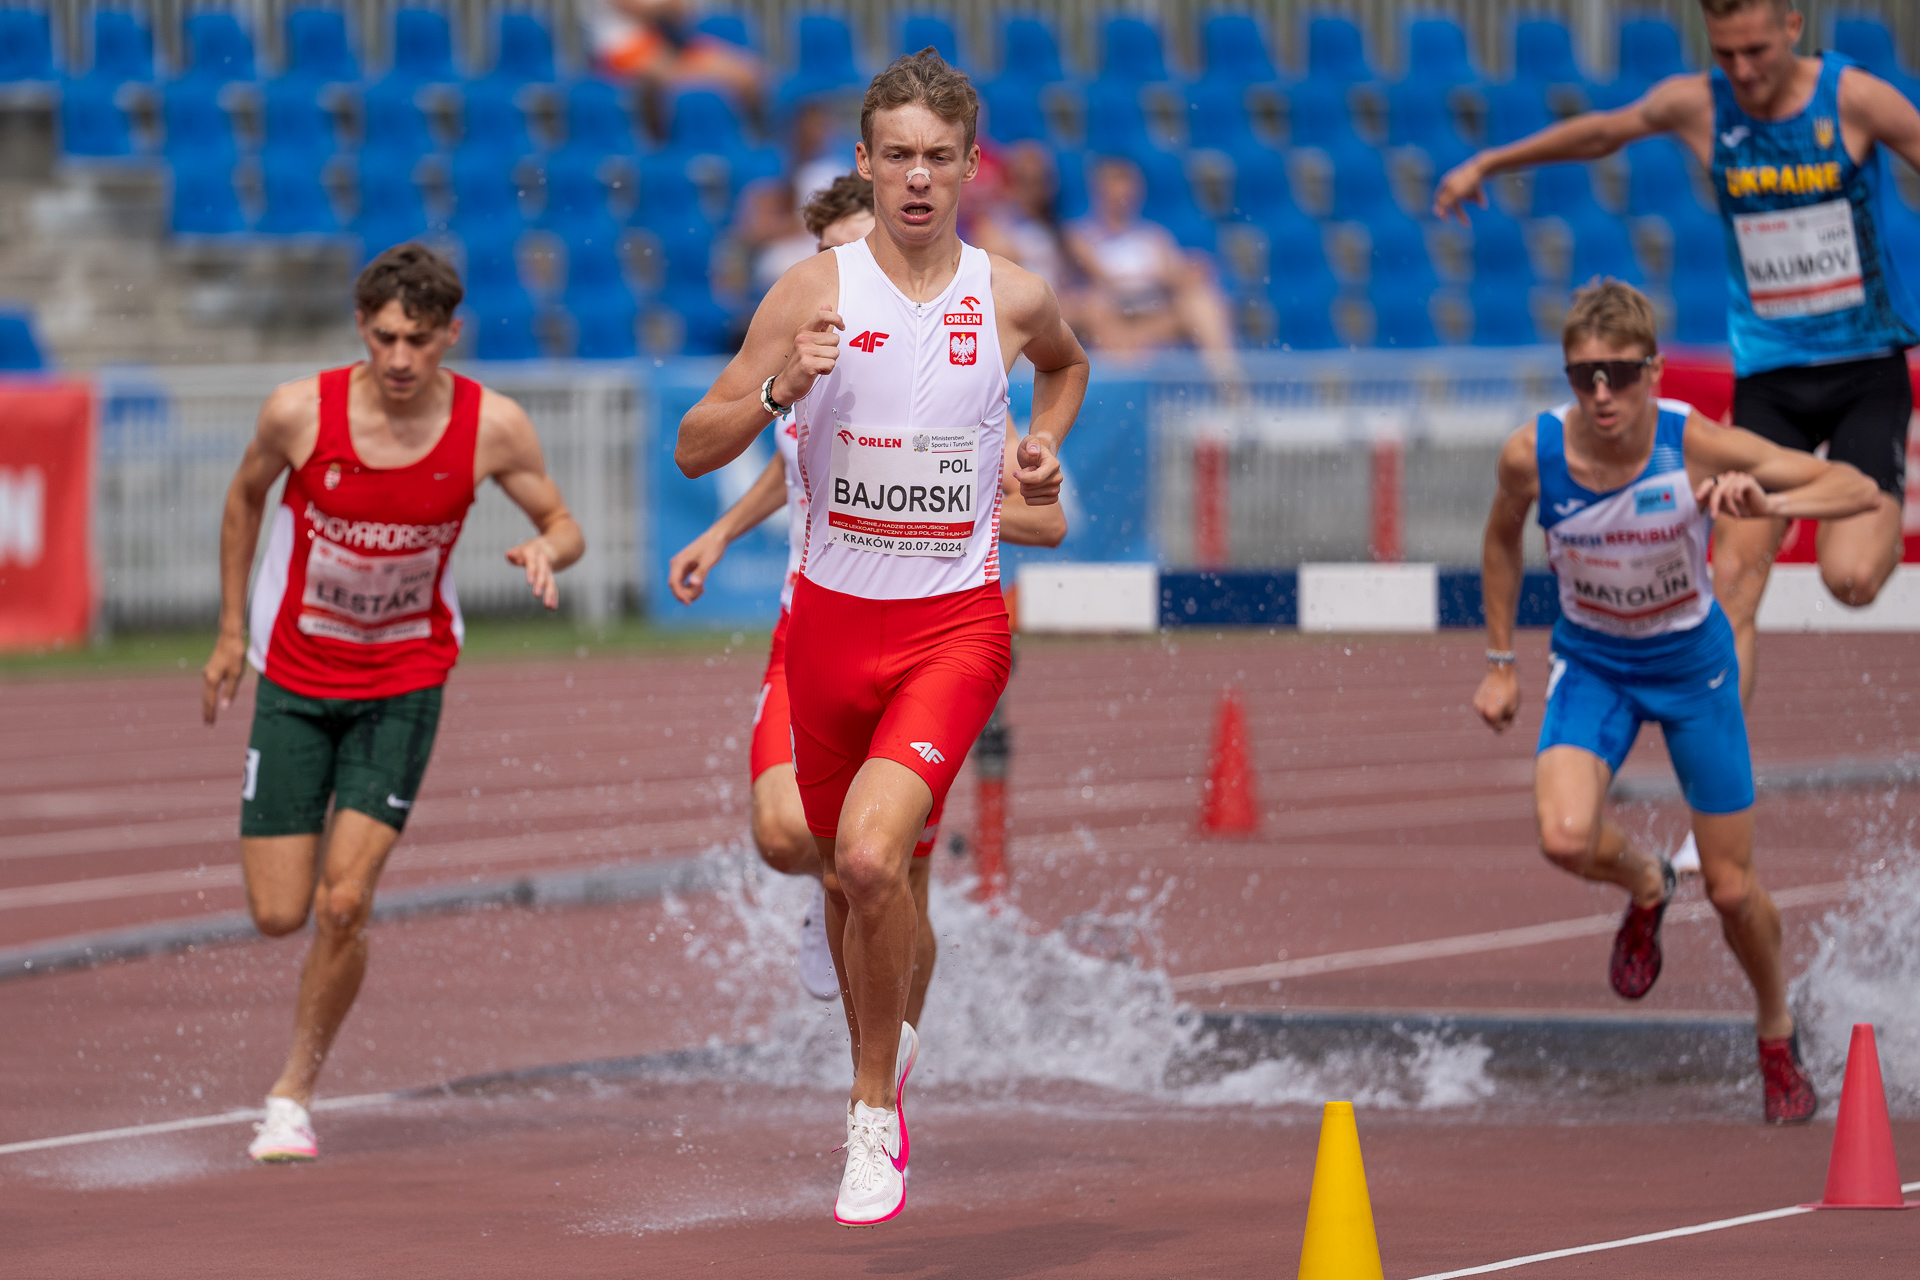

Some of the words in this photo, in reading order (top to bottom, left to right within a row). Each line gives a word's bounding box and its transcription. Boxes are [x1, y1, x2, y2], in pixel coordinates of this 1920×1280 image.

[1725, 160, 1842, 198] UKRAINE
[1750, 248, 1852, 283] NAUMOV
[945, 314, 981, 324] ORLEN
[849, 330, 890, 353] 4F
[858, 437, 902, 448] ORLEN
[953, 440, 974, 448] Turystyki
[939, 459, 973, 474] POL
[834, 477, 971, 513] BAJORSKI
[832, 520, 848, 528] MECZ
[857, 519, 881, 527] TURNIEJ
[843, 533, 894, 549] KRAKÓW
[897, 541, 962, 552] 20.07.2024
[910, 741, 945, 764] 4F
